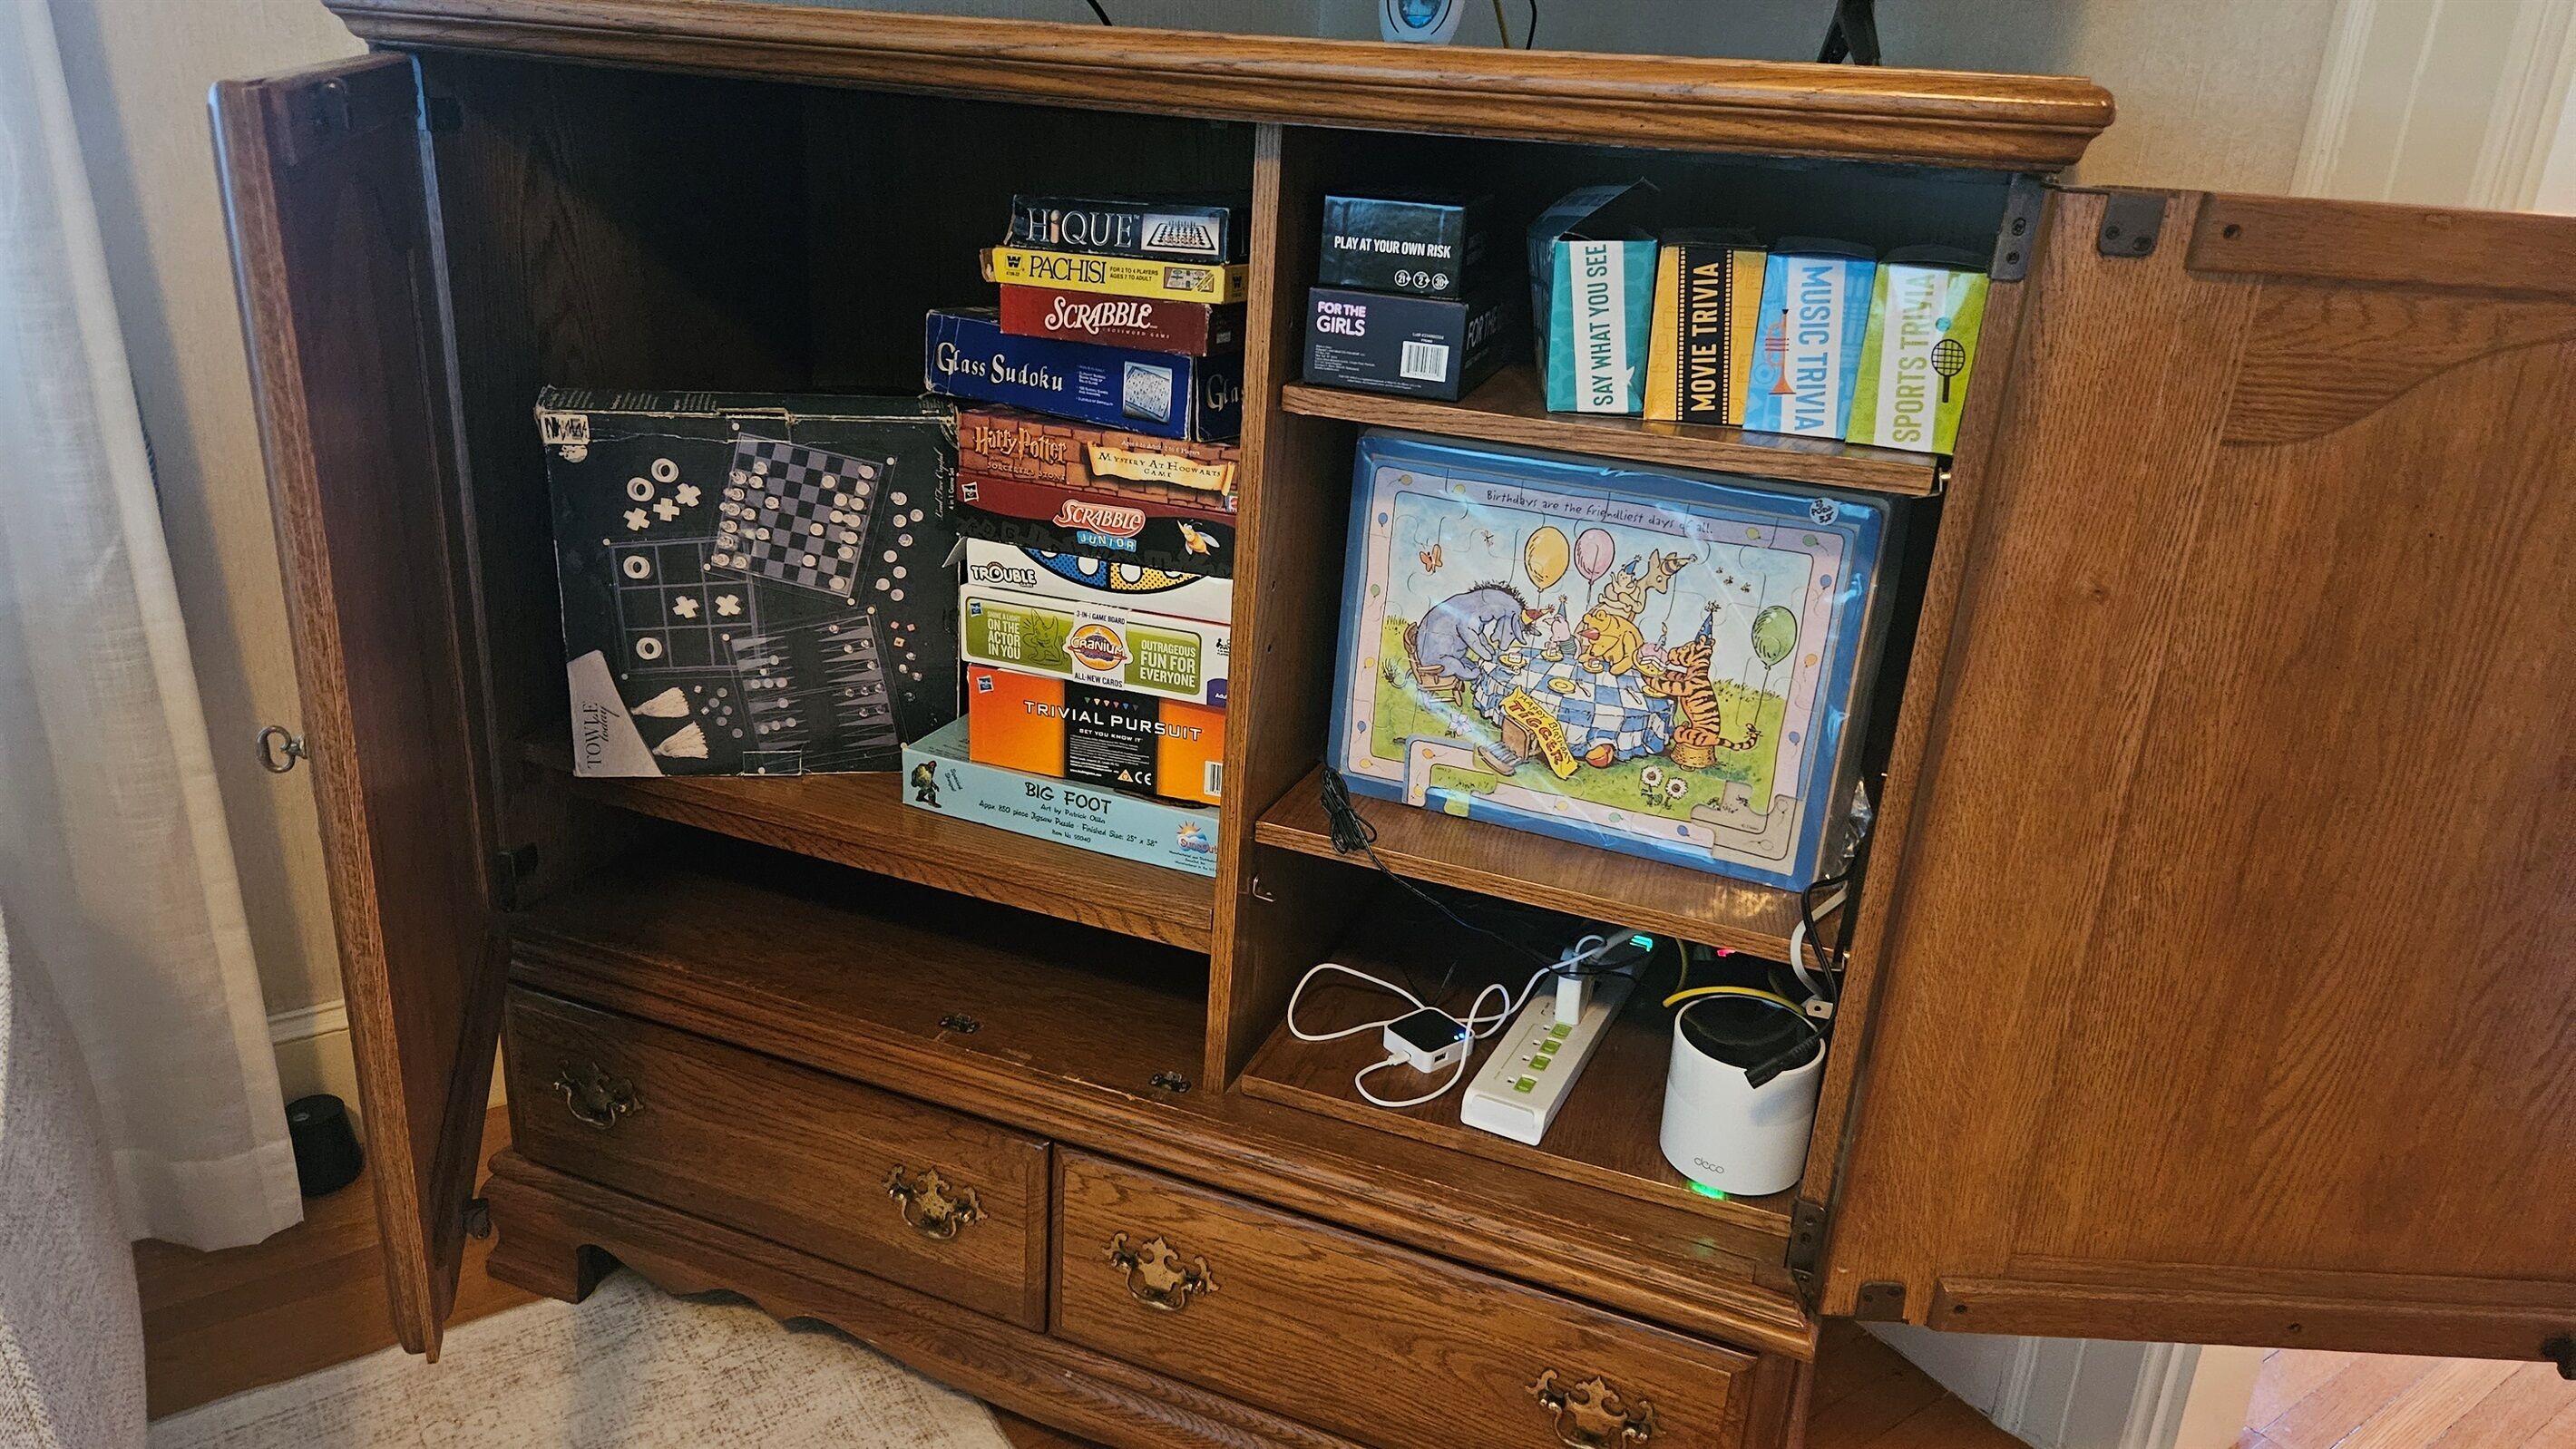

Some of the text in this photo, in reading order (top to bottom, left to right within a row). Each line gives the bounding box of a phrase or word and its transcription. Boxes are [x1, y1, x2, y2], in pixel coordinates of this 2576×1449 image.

[1334, 236, 1451, 259] PLAY AT YOUR OWN RISK
[1029, 255, 1107, 284] PACHISI
[1045, 296, 1153, 336] SCRABBLE
[1318, 301, 1367, 317] FOR THE
[1150, 331, 1170, 339] GAME
[1316, 315, 1365, 336] GIRLS
[1585, 244, 1614, 406] SAY WHAT YOU SEE
[1691, 262, 1720, 412] MOVIE TRIVIA
[1794, 266, 1833, 432] MUSIC TRIVIA
[1892, 274, 1936, 443] SPORTS TRIVIA
[936, 342, 986, 376] Glass
[990, 354, 1063, 392] Sudoku
[972, 426, 1067, 465] Harry Potter
[1144, 468, 1172, 478] GAME
[1057, 503, 1143, 533] SCRABBLE
[1487, 490, 1537, 507] Birthdays
[1542, 501, 1559, 509] are
[1564, 503, 1582, 513] the
[1648, 515, 1673, 529] days
[1079, 533, 1135, 551] JUNIOR
[971, 563, 1037, 584] TROUBLE
[987, 618, 1020, 635] ON THE
[1091, 613, 1107, 622] GAME
[1107, 616, 1126, 626] BOARD
[987, 631, 1020, 647] ACTOR
[1141, 639, 1196, 658] OUTRAGEOUS
[988, 644, 1021, 660] IN YOU
[1140, 651, 1195, 675] FUN FOR
[1074, 673, 1123, 688] ALL-NEW CARDS
[1140, 667, 1195, 688] EVERYONE
[1518, 695, 1548, 719] HAPPY
[1023, 700, 1203, 741] TRIVIAL PURSUIT
[582, 701, 602, 769] TOWLE
[1111, 734, 1133, 742] KNOW
[1508, 700, 1564, 765] TIGGER
[1135, 771, 1152, 786] CE
[1024, 782, 1112, 814] BIG FOOT
[998, 804, 1010, 813] 850
[1013, 809, 1029, 818] piece
[1031, 812, 1052, 823] Jigsaw
[1055, 817, 1075, 829] Puzzle
[1082, 823, 1107, 835] Finished
[1040, 803, 1051, 812] Art
[1054, 807, 1062, 815] by
[1064, 809, 1087, 820] Patrick
[1693, 1157, 1725, 1174] deco
